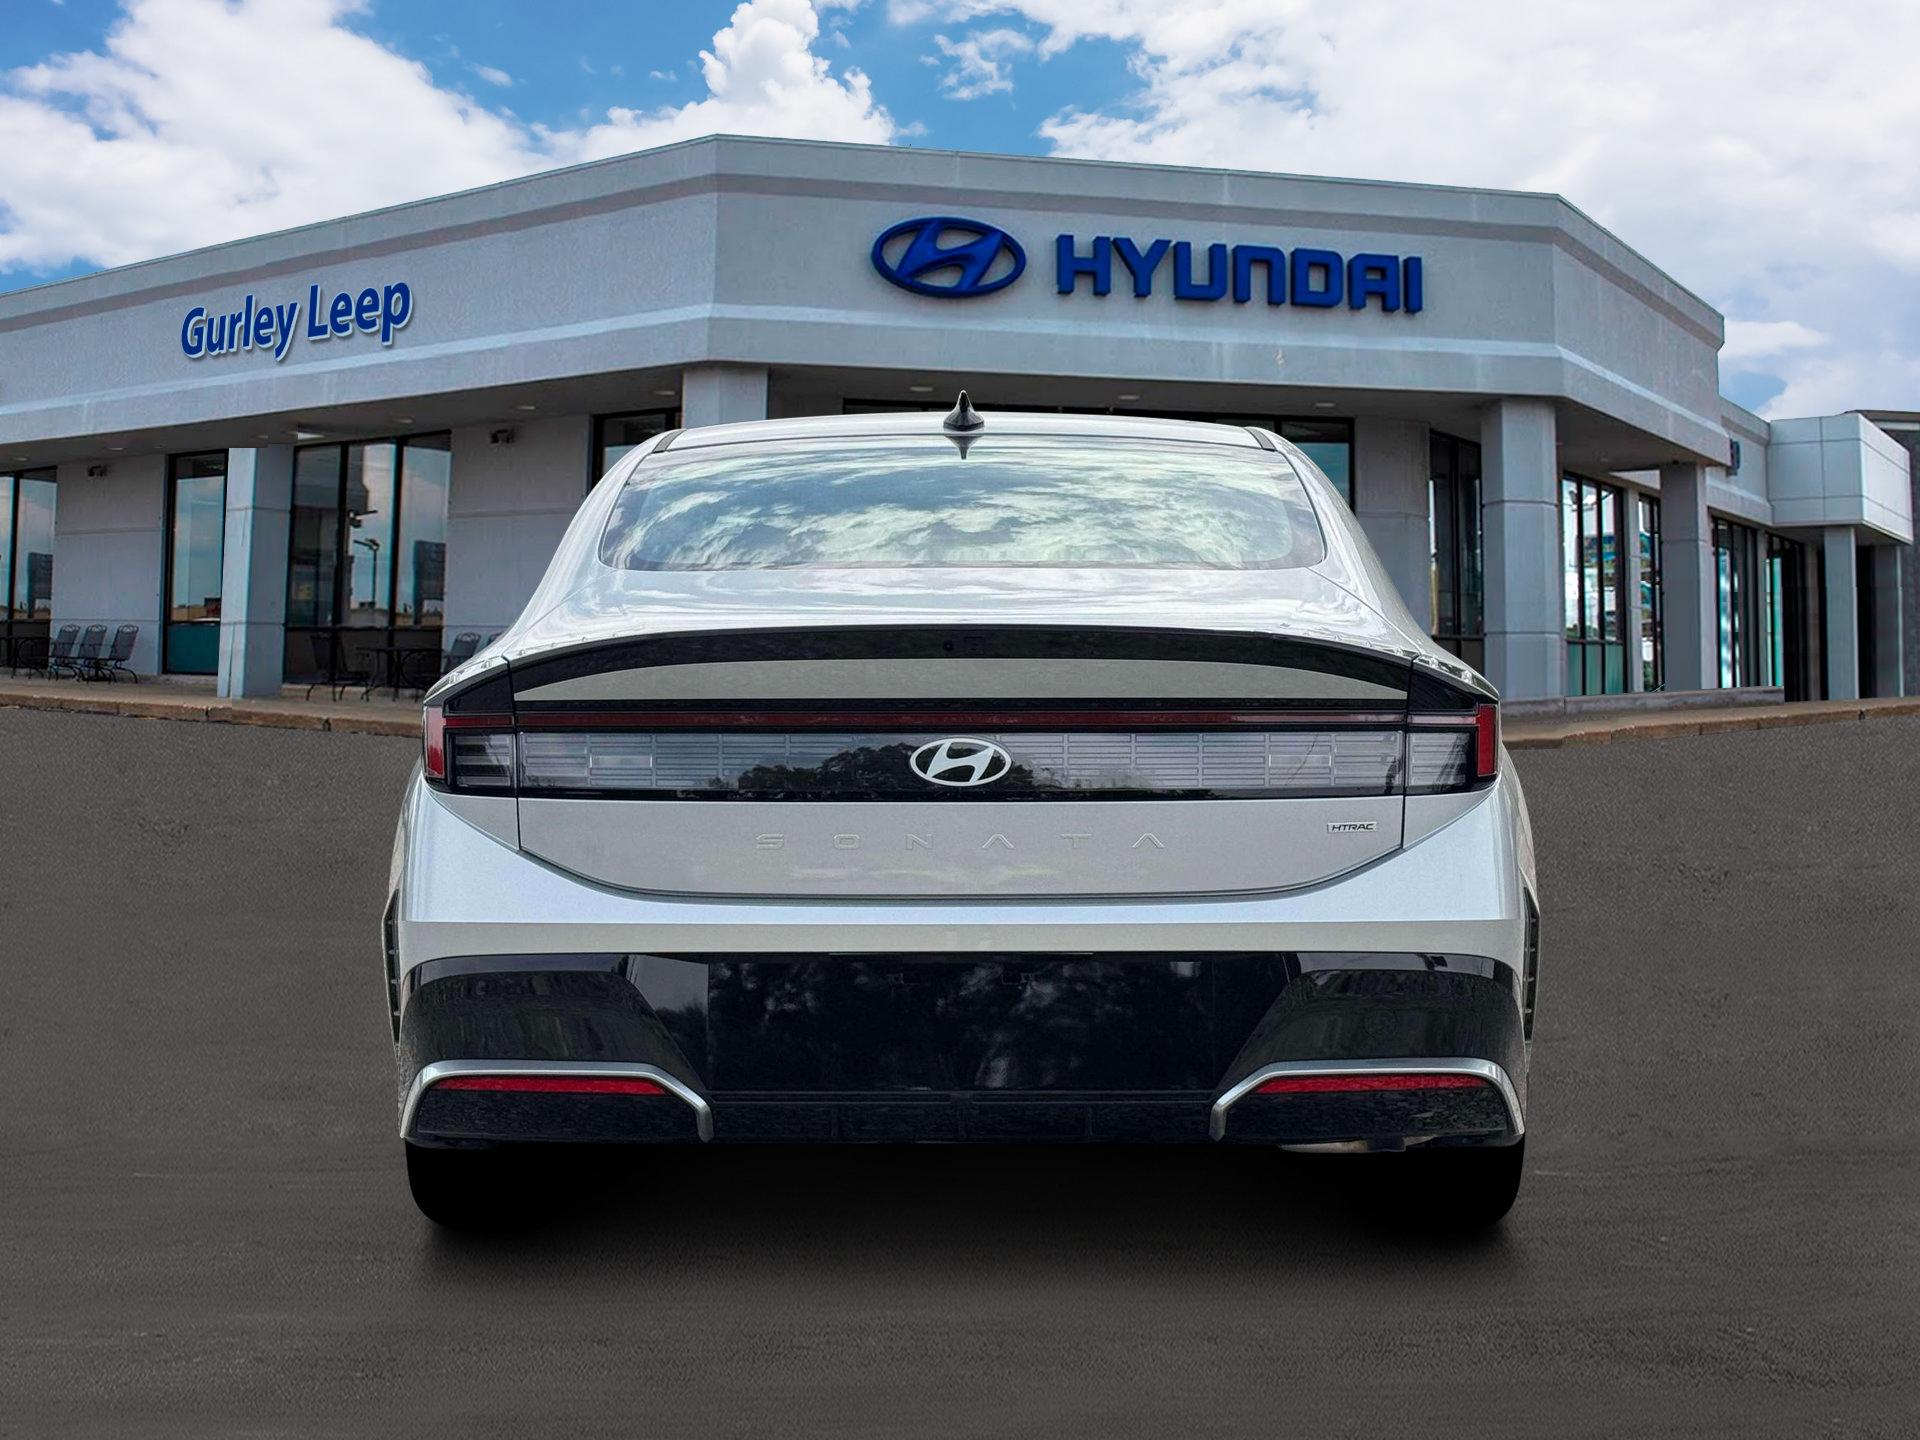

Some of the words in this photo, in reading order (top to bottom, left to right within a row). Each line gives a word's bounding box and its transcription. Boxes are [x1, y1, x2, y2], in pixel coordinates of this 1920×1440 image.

[1056, 234, 1423, 314] HYUNDAI
[181, 294, 298, 361] Gurley
[307, 281, 413, 346] Leep
[755, 832, 1166, 850] SONATA
[1331, 823, 1375, 832] HTRAC
